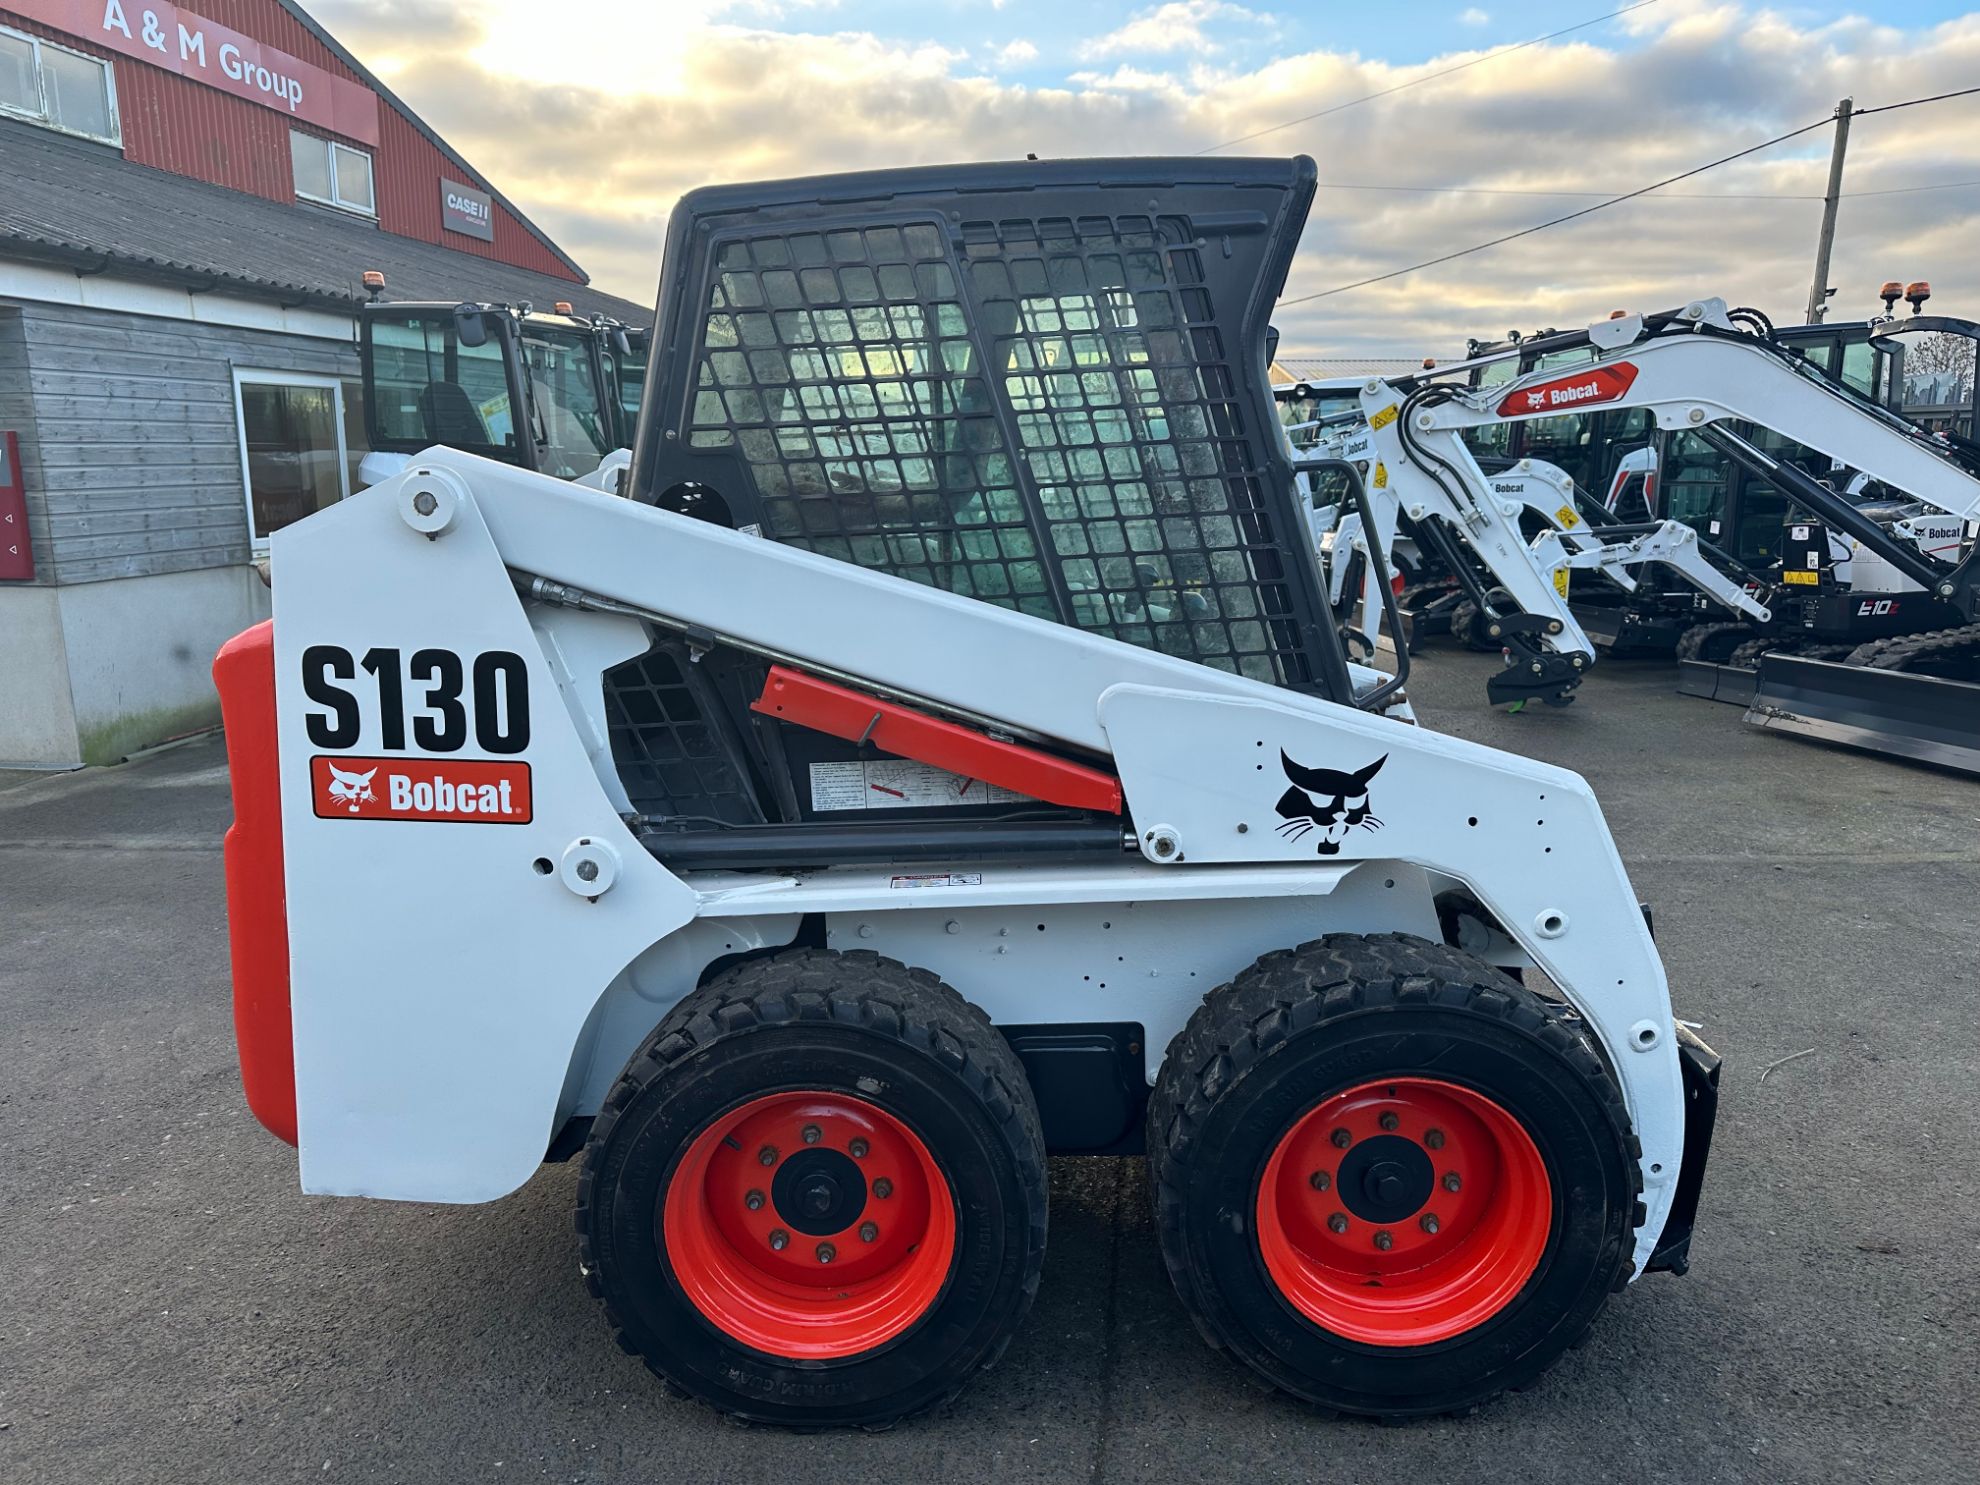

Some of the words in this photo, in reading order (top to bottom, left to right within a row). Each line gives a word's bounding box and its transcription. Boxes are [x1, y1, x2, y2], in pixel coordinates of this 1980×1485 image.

[103, 0, 132, 39] A
[142, 10, 167, 53] &
[178, 23, 206, 68] M
[219, 43, 303, 112] Group
[447, 193, 478, 217] CASE
[1550, 381, 1599, 405] Bobcat
[1495, 483, 1524, 493] Bobcat
[1928, 527, 1960, 539] Bobcat
[302, 645, 531, 755] S130
[388, 774, 513, 815] Bobcat
